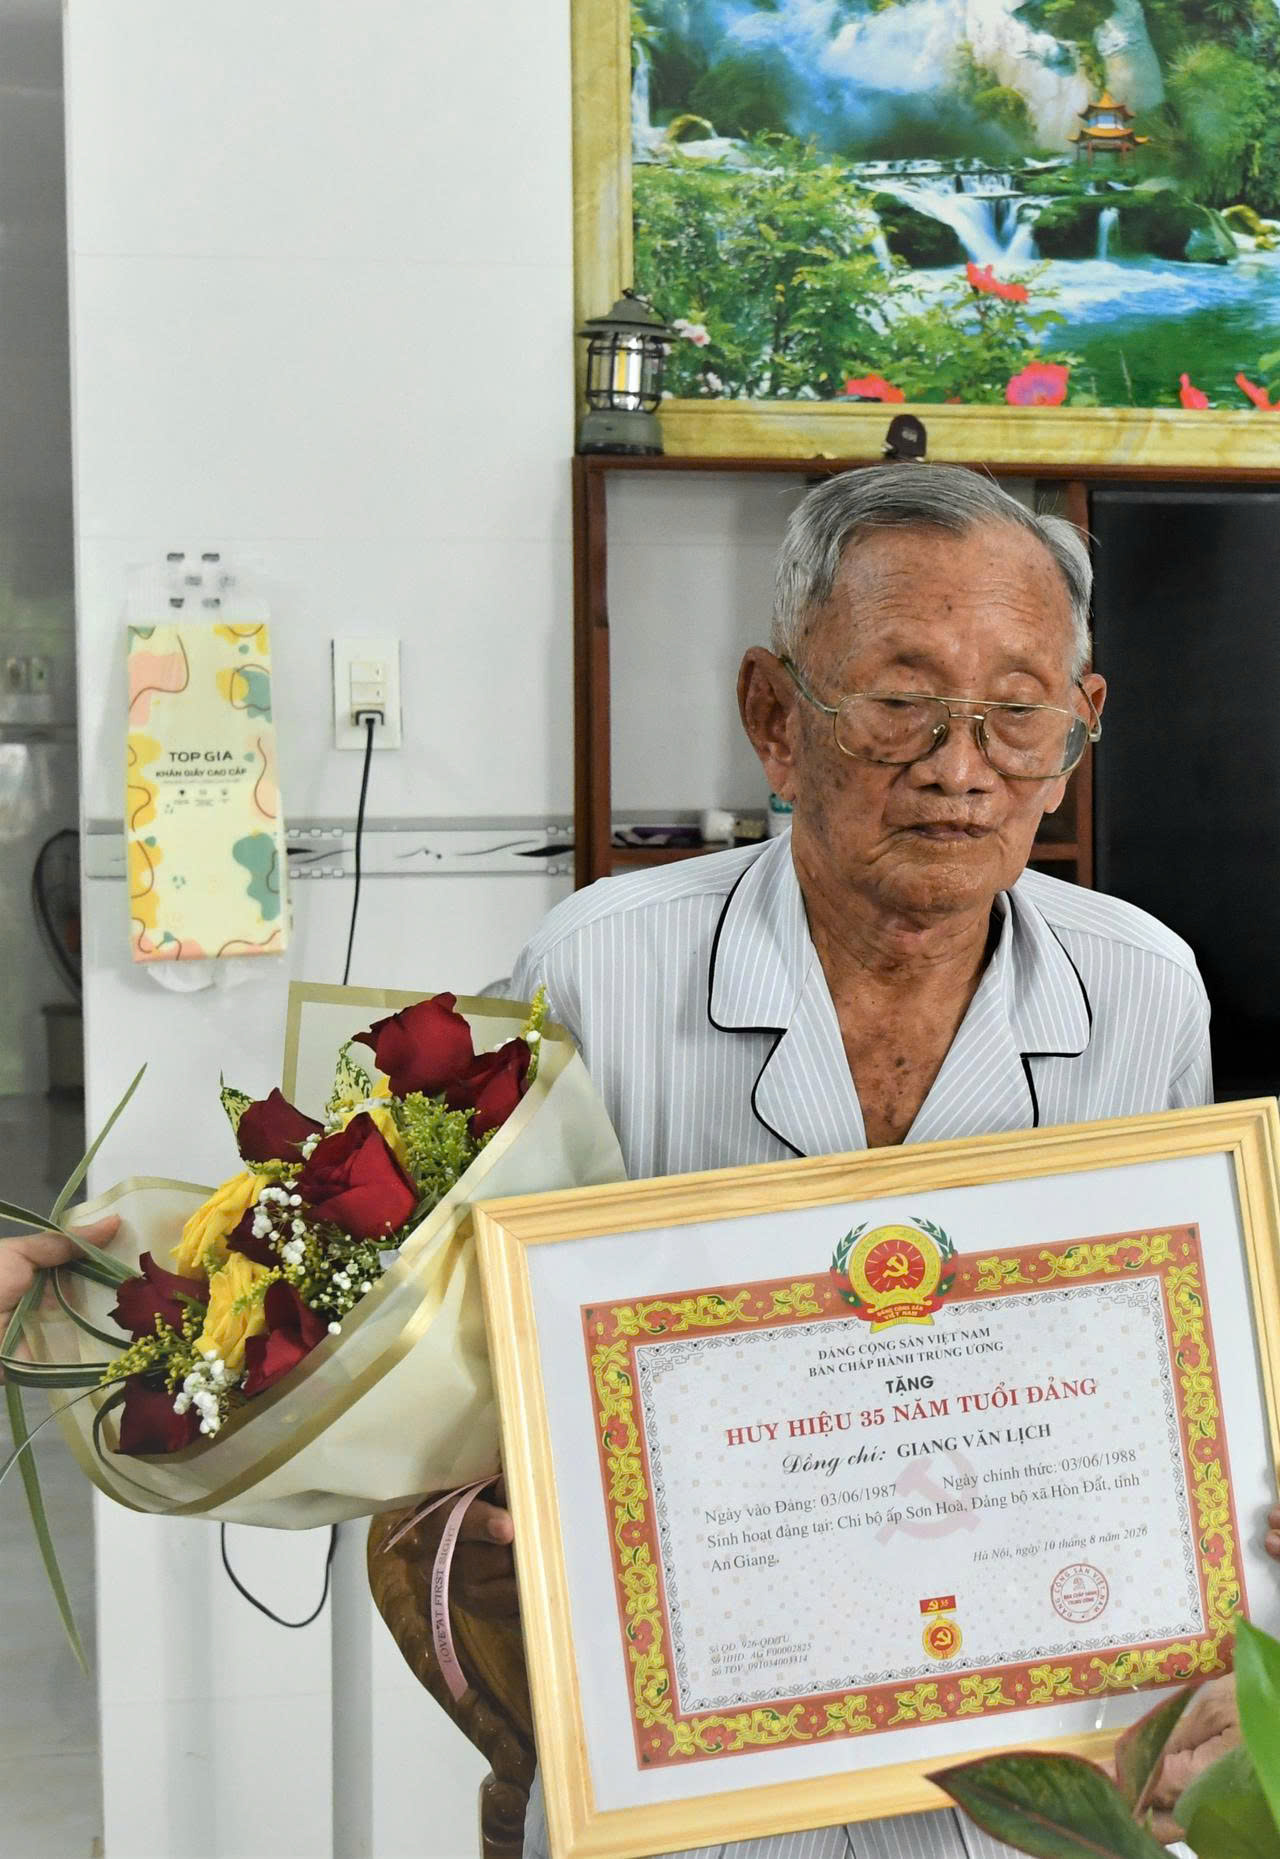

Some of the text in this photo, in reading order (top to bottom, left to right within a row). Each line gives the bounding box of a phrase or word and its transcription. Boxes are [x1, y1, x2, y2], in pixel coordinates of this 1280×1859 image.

[169, 750, 233, 762] TOP GIA
[207, 768, 227, 777] CAO
[809, 1364, 836, 1377] BAN
[877, 1352, 915, 1367] HÀNH
[917, 1347, 962, 1363] TRUNG
[965, 1341, 1005, 1355] ƯƠNG
[818, 1327, 991, 1360] ĐẢNG CỘNG SẢN VIỆT NAM
[885, 1375, 935, 1396] TẶNG
[725, 1376, 1098, 1447] HUY HIỆU 35 NĂM TUỔI ĐẢNG
[782, 1423, 1051, 1477] Đồng chí: GIANG VĂN LỊCH
[704, 1449, 1137, 1526] Ngày vào Đảng: 03/06/1987 Ngày chính thức: 03/06/1988
[707, 1531, 740, 1549] Sinh
[742, 1527, 773, 1545] hoạt
[775, 1523, 810, 1540] đảng
[812, 1520, 834, 1534] tại:
[837, 1514, 862, 1530] Chi
[865, 1510, 884, 1526] bộ
[886, 1506, 903, 1525] ấp
[905, 1504, 932, 1519] Sơn
[936, 1500, 968, 1516] Hoà,
[971, 1495, 1009, 1510] Đảng
[1011, 1490, 1029, 1505] bộ
[1031, 1489, 1049, 1501] xã
[1051, 1484, 1081, 1498] Hòn
[1115, 1473, 1140, 1489] tỉnh
[972, 1526, 1149, 1562] Hà Nội, ngày 10 tháng 8 năm 2026
[711, 1553, 780, 1573] An Giang.
[434, 1526, 456, 1664] LOVE AT FIRST SIGHT
